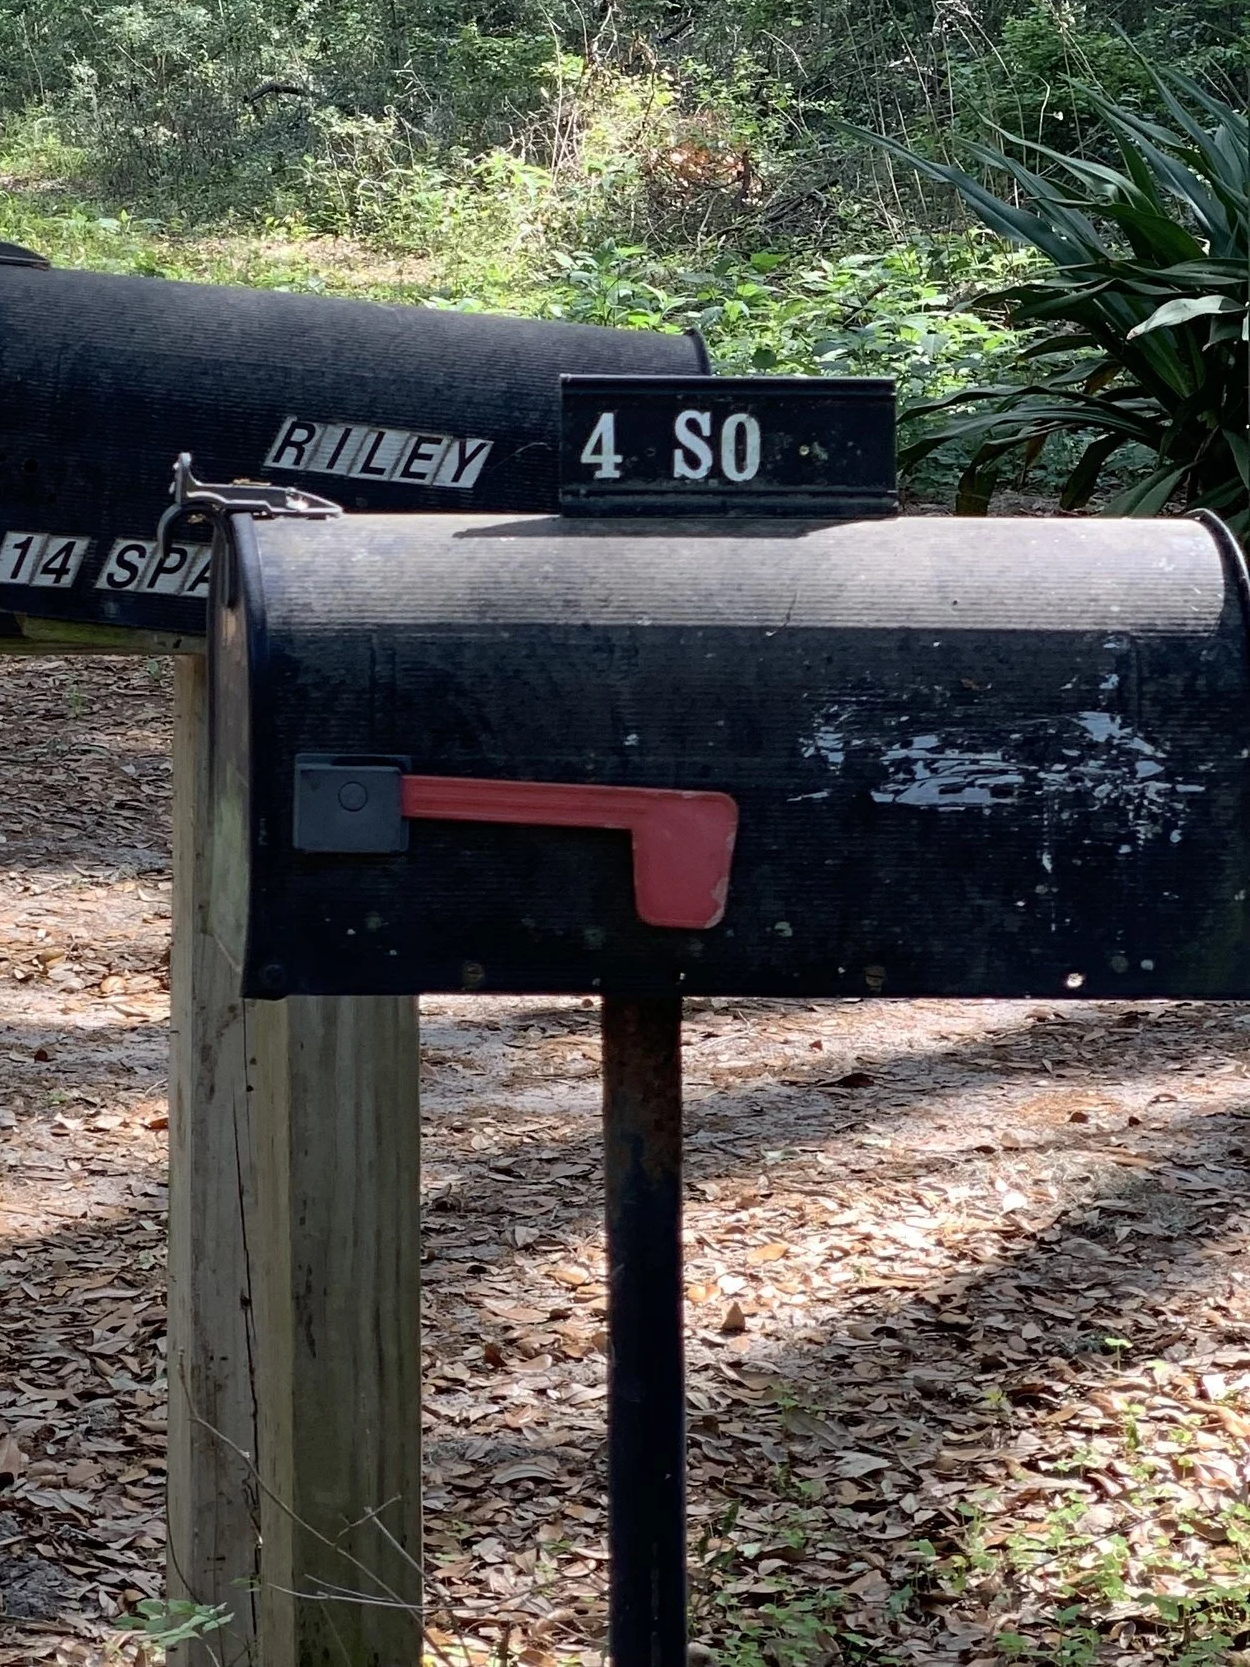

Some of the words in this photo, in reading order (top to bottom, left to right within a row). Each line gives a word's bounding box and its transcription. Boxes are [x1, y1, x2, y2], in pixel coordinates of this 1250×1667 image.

[271, 421, 488, 483] RILEY
[580, 412, 623, 479] 4
[10, 536, 77, 584] 14
